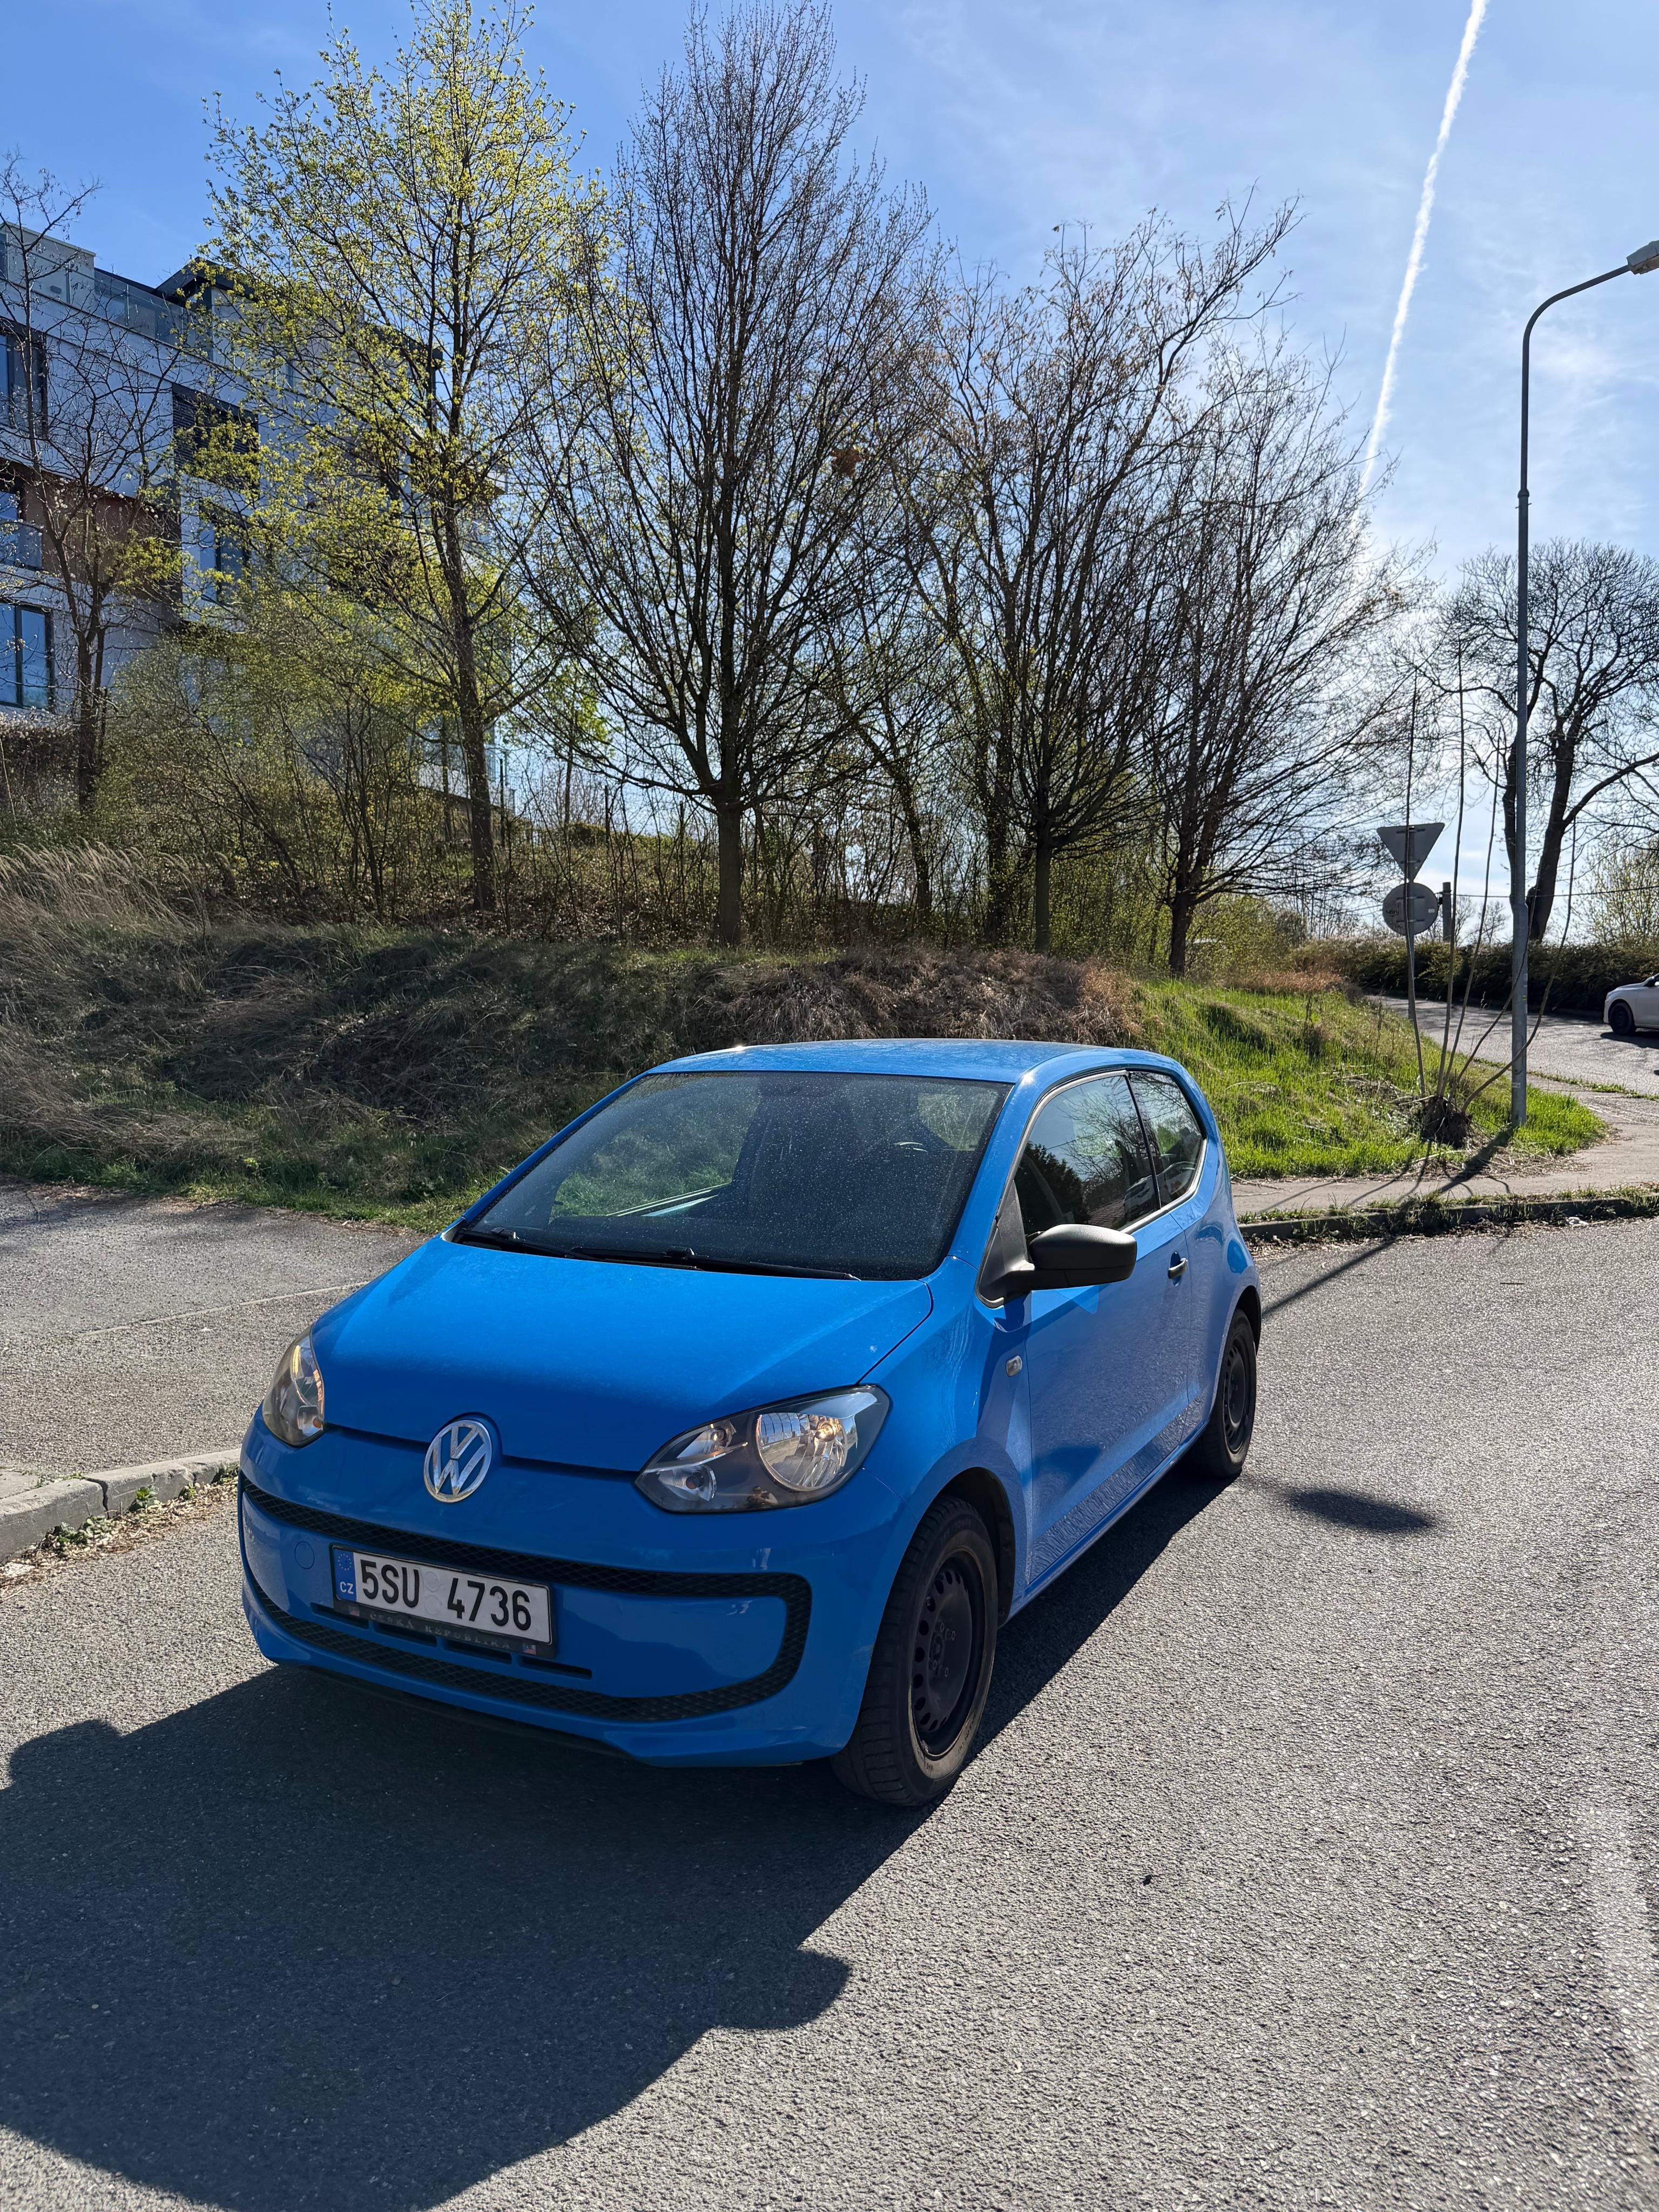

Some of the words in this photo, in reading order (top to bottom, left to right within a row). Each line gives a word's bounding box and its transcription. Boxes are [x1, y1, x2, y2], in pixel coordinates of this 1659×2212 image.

[424, 1420, 492, 1503] VW
[340, 1581, 354, 1595] CZ
[360, 1559, 420, 1608] 5SU
[448, 1577, 531, 1631] 4736
